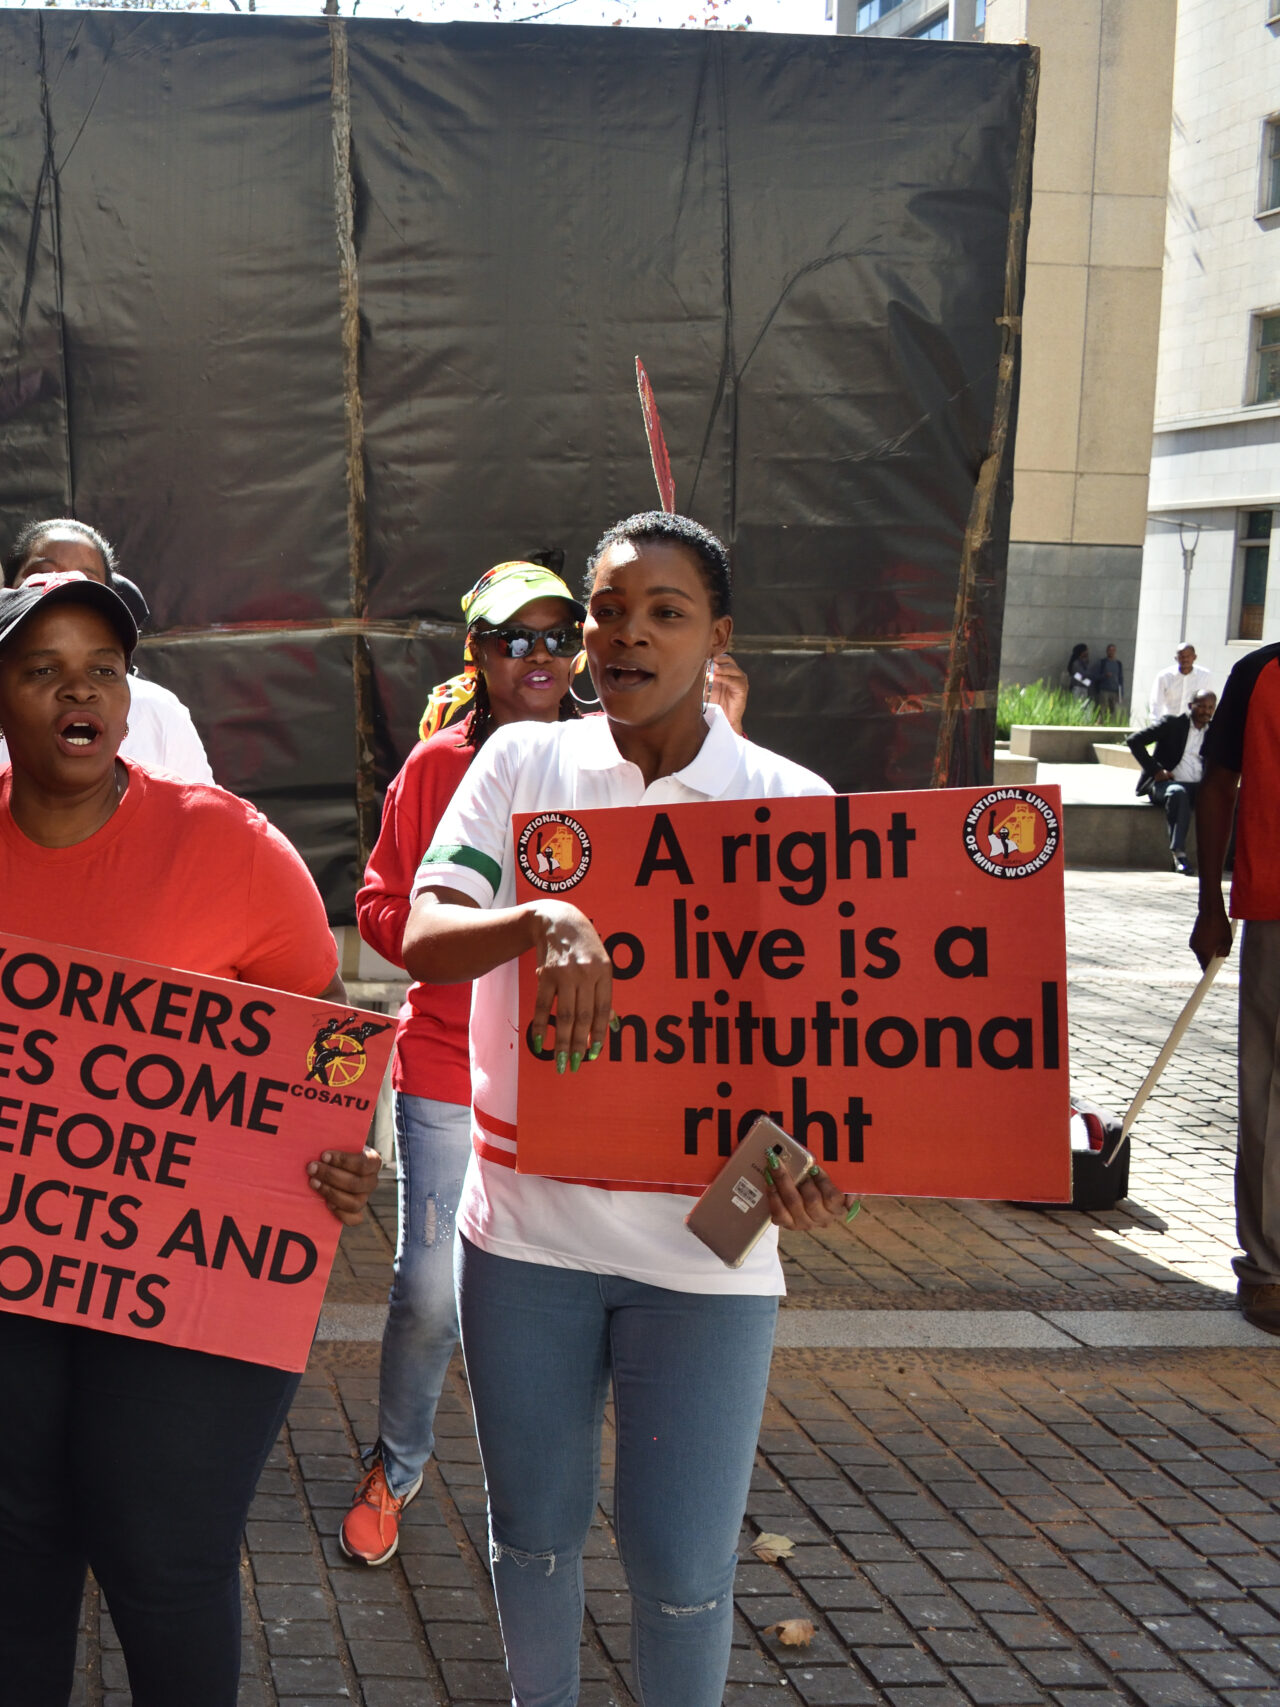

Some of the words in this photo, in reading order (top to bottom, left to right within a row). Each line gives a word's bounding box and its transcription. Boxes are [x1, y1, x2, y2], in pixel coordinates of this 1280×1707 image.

[967, 789, 1023, 825] NATIONAL
[1025, 792, 1058, 829] UNION
[520, 813, 562, 845] NATIONAL
[564, 815, 590, 848] UNION
[634, 812, 694, 887] A
[722, 796, 917, 905] right
[520, 854, 530, 868] OF
[525, 868, 549, 890] MINE
[550, 856, 590, 890] WORKERS
[965, 835, 978, 851] OF
[972, 852, 1004, 876] MINE
[1005, 836, 1057, 877] WORKERS
[674, 898, 805, 980] live
[838, 900, 901, 980] is
[934, 925, 988, 979] a
[80, 1045, 291, 1136] COME
[290, 1084, 370, 1111] COSATU
[158, 1207, 318, 1285] AND
